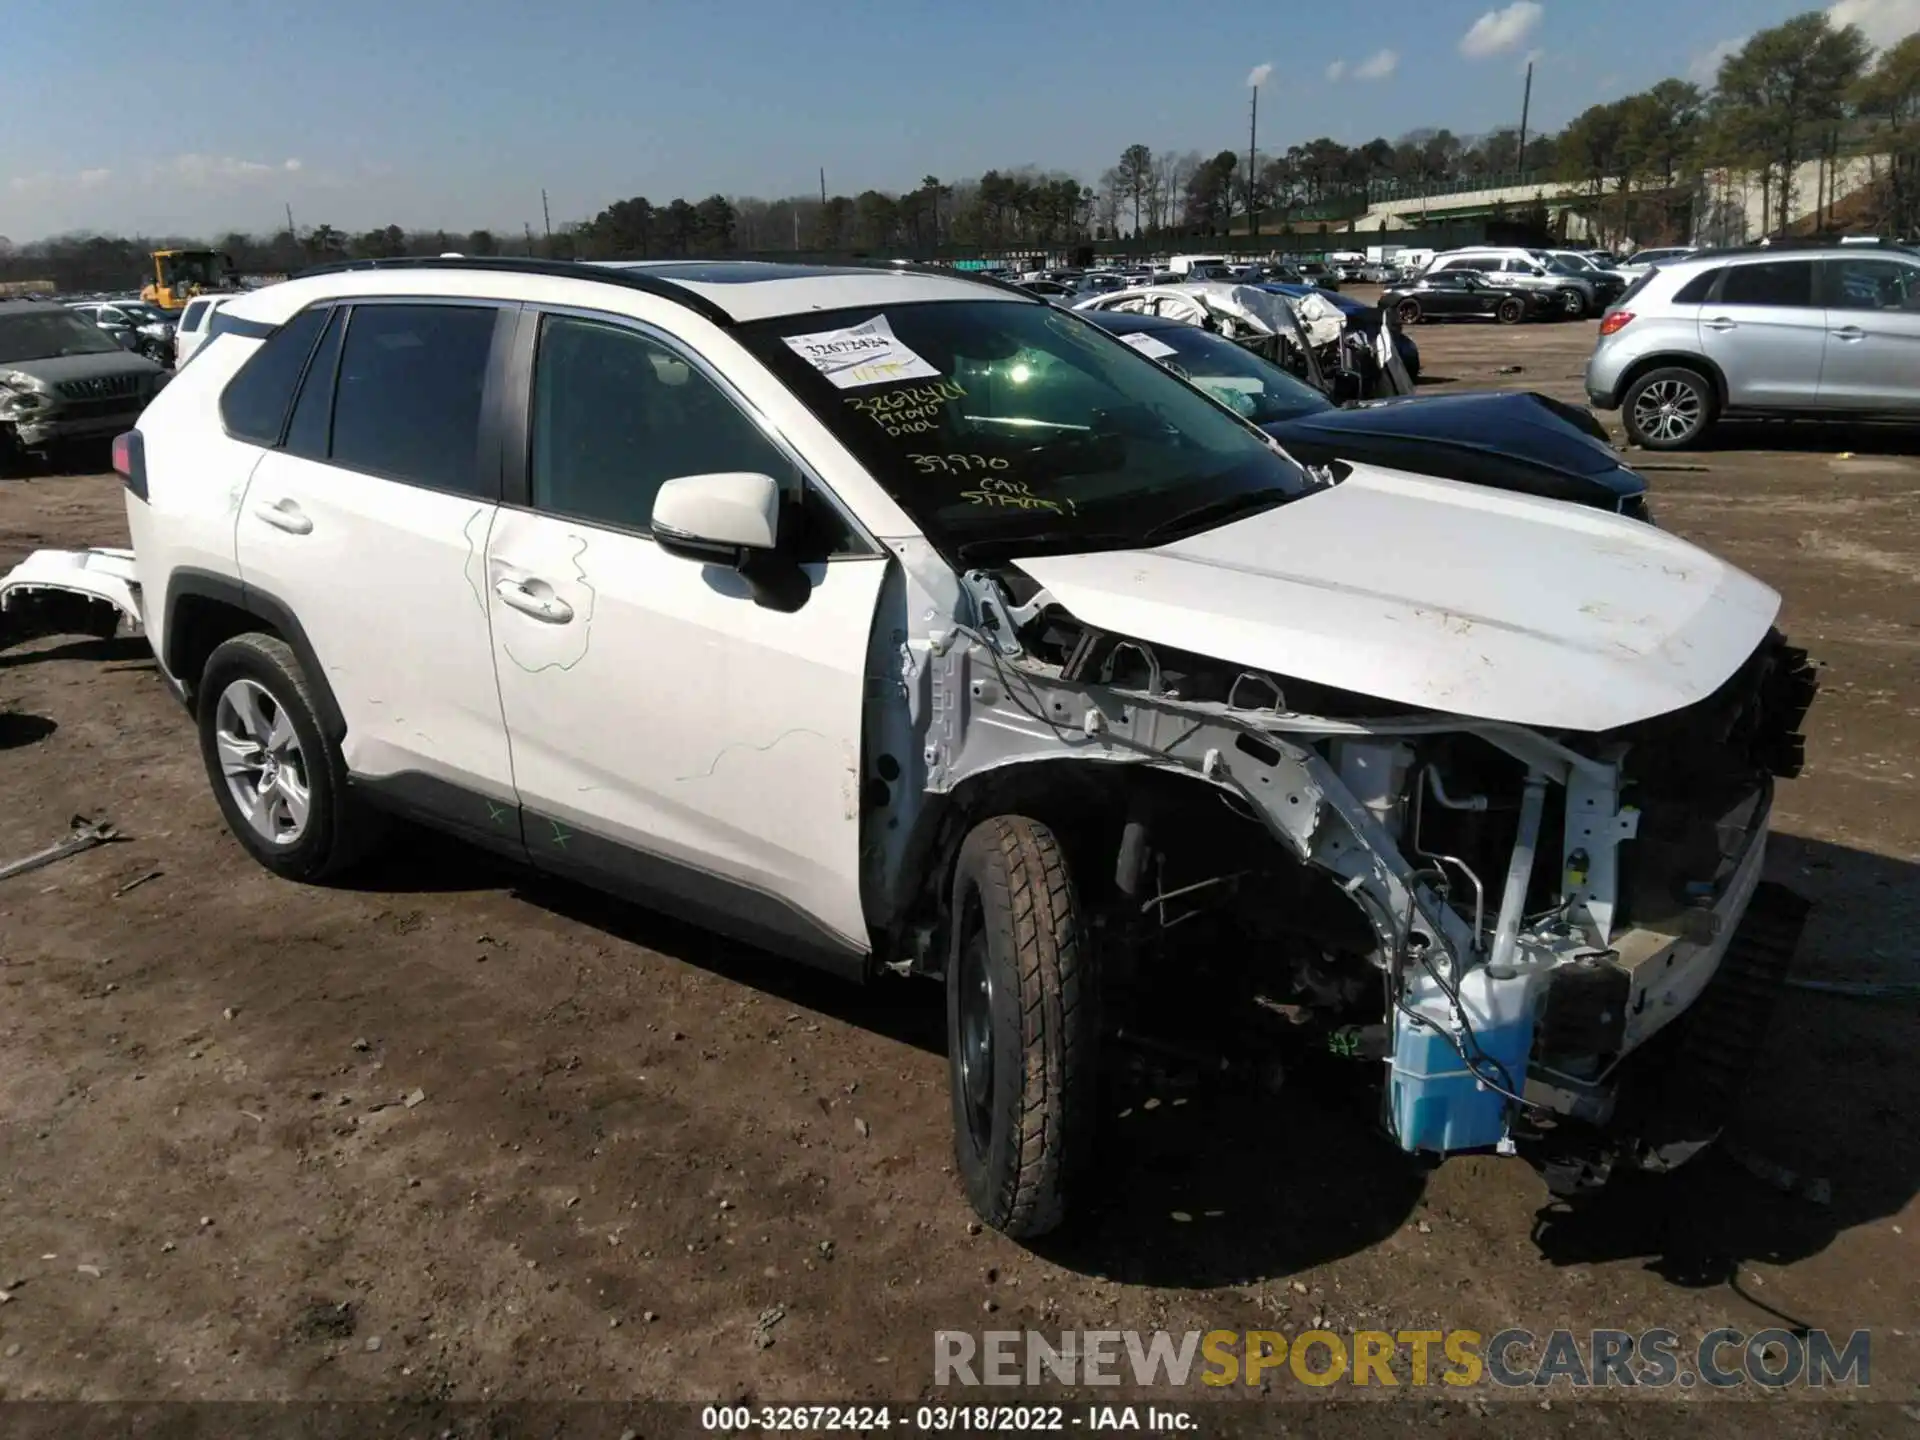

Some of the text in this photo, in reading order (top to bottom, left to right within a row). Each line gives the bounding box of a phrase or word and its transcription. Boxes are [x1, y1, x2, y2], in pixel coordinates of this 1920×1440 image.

[805, 337, 889, 356] 32672424
[844, 378, 967, 415] 32672424
[906, 454, 1009, 475] 39,970
